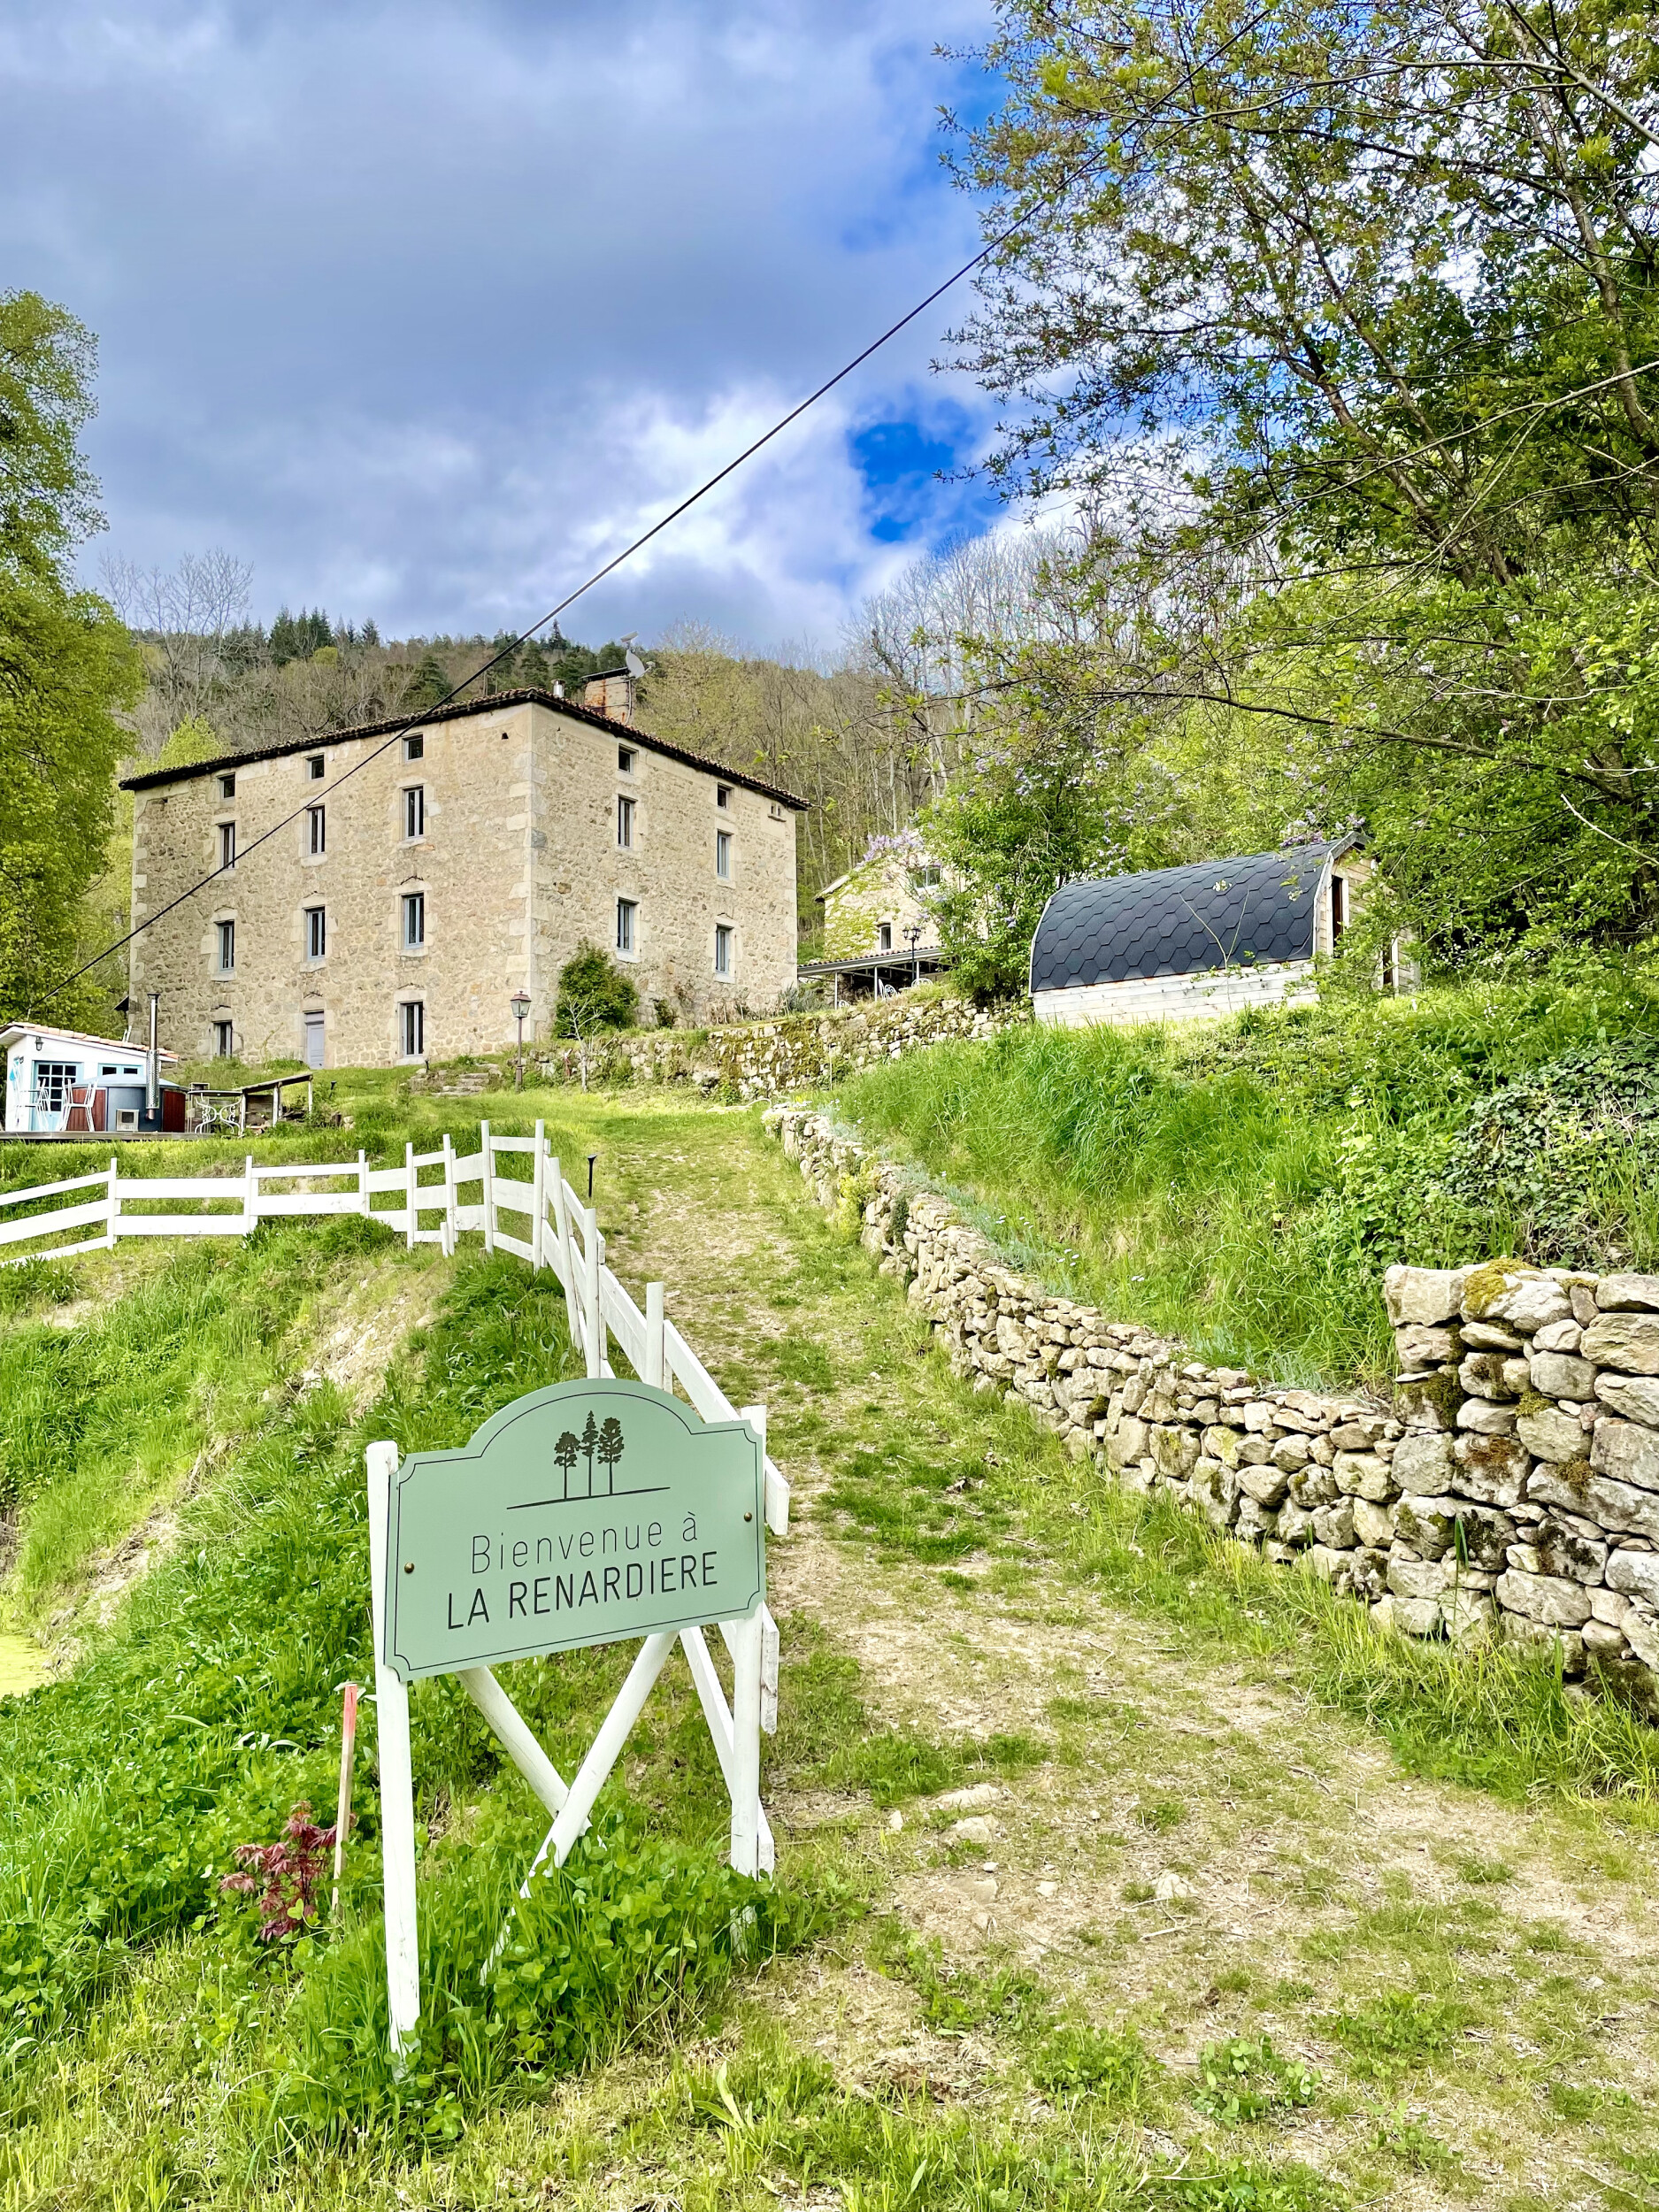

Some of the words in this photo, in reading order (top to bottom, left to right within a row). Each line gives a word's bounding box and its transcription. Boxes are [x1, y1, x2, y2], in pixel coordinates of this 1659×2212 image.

[472, 1521, 662, 1574] Bienvenue
[682, 1512, 698, 1541] à
[448, 1587, 489, 1630] LA
[509, 1551, 718, 1618] RENARDIERE
